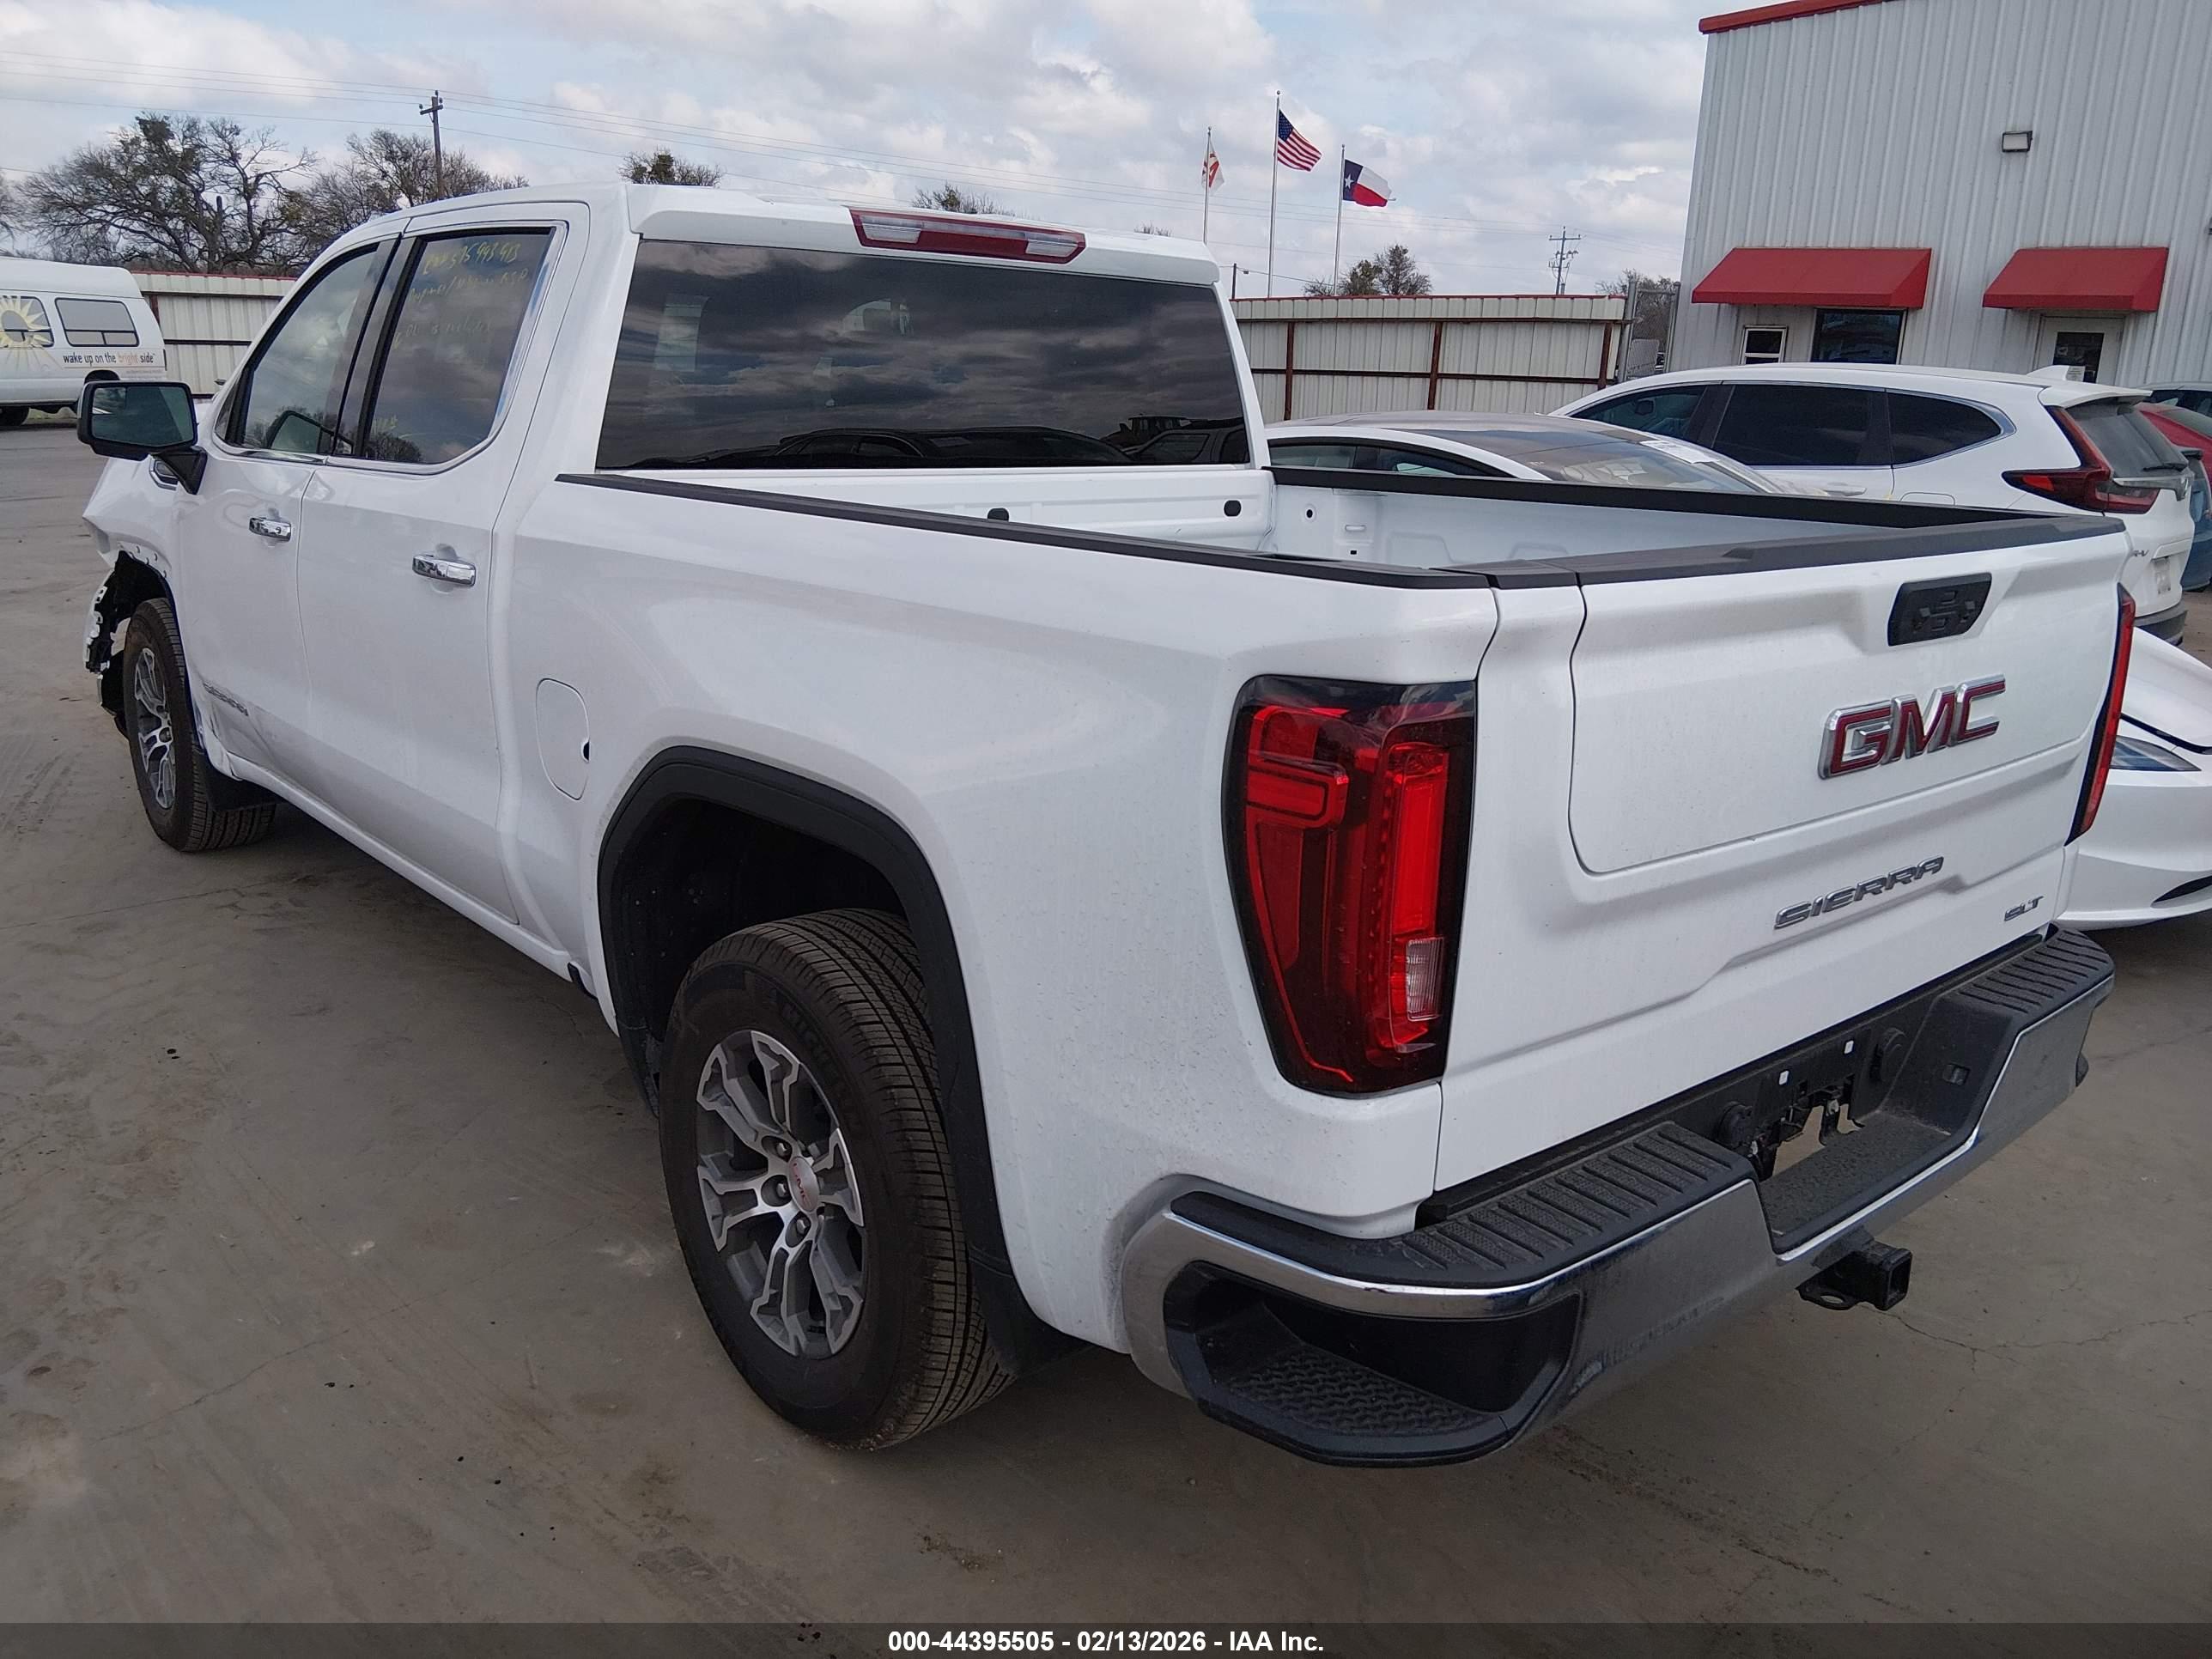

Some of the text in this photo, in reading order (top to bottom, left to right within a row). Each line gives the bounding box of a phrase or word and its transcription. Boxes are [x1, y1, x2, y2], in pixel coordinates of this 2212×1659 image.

[63, 352, 82, 363] wake
[84, 354, 93, 367] up
[95, 354, 104, 363] on
[104, 351, 117, 363] the
[118, 351, 138, 366] bright
[1818, 673, 2007, 780] GMC
[1774, 855, 1945, 930] SIERRA
[2003, 895, 2045, 922] SLT
